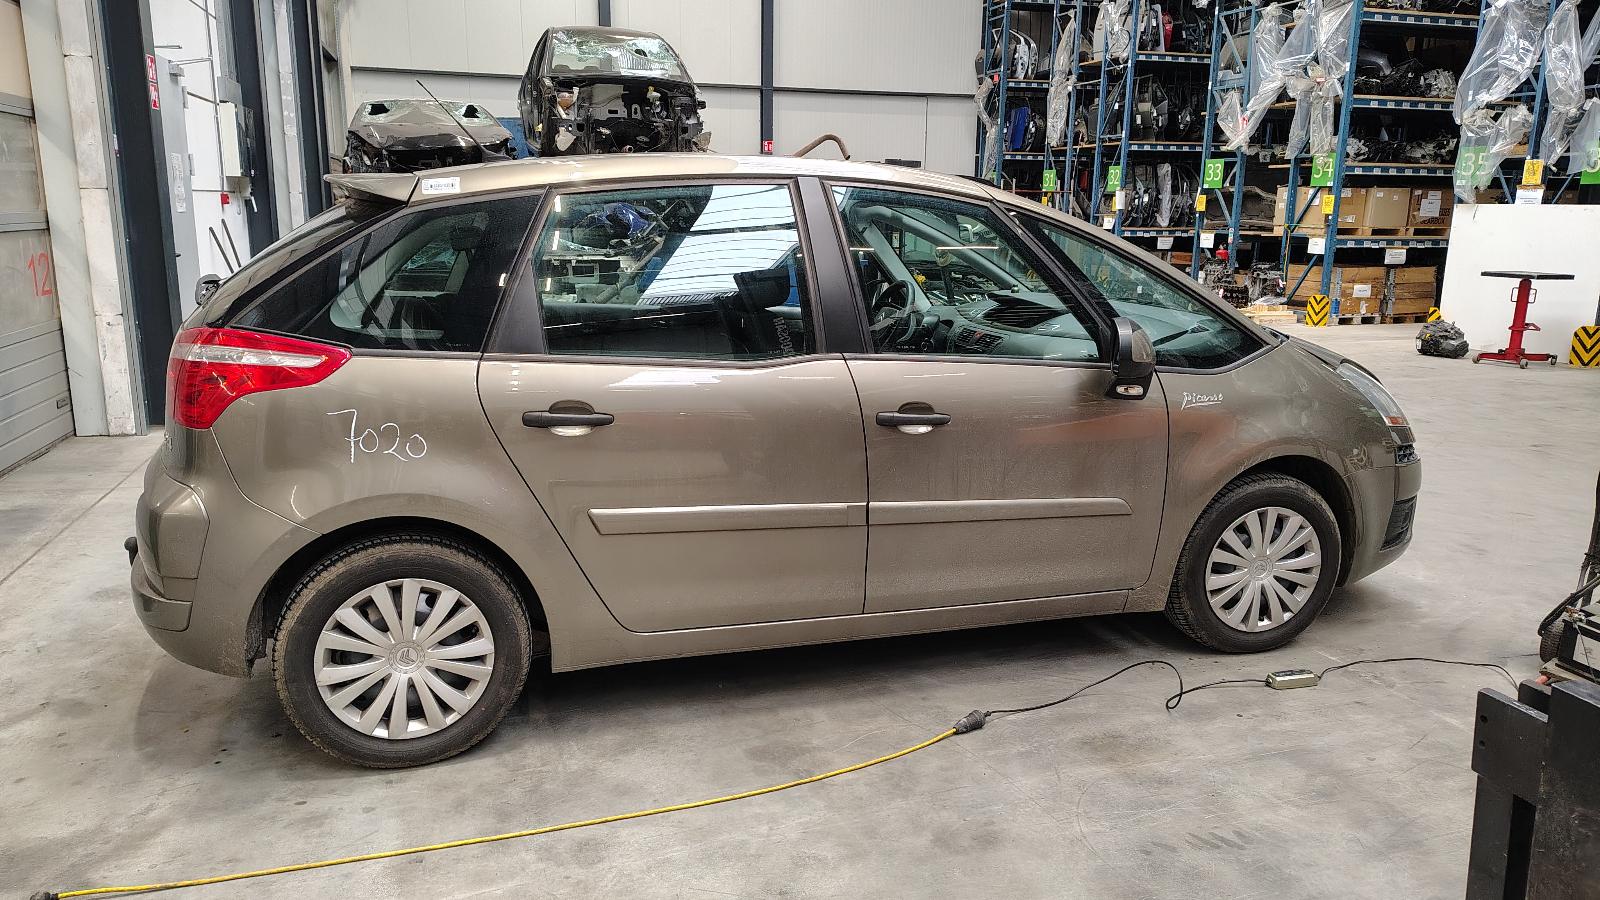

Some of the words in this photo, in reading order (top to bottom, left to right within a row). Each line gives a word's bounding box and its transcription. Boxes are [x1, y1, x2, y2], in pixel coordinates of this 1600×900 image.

[1206, 164, 1221, 181] 33
[1462, 152, 1490, 176] 35
[1044, 173, 1054, 187] 31
[1109, 170, 1120, 184] 32
[28, 252, 53, 296] 12
[326, 408, 428, 463] 7020
